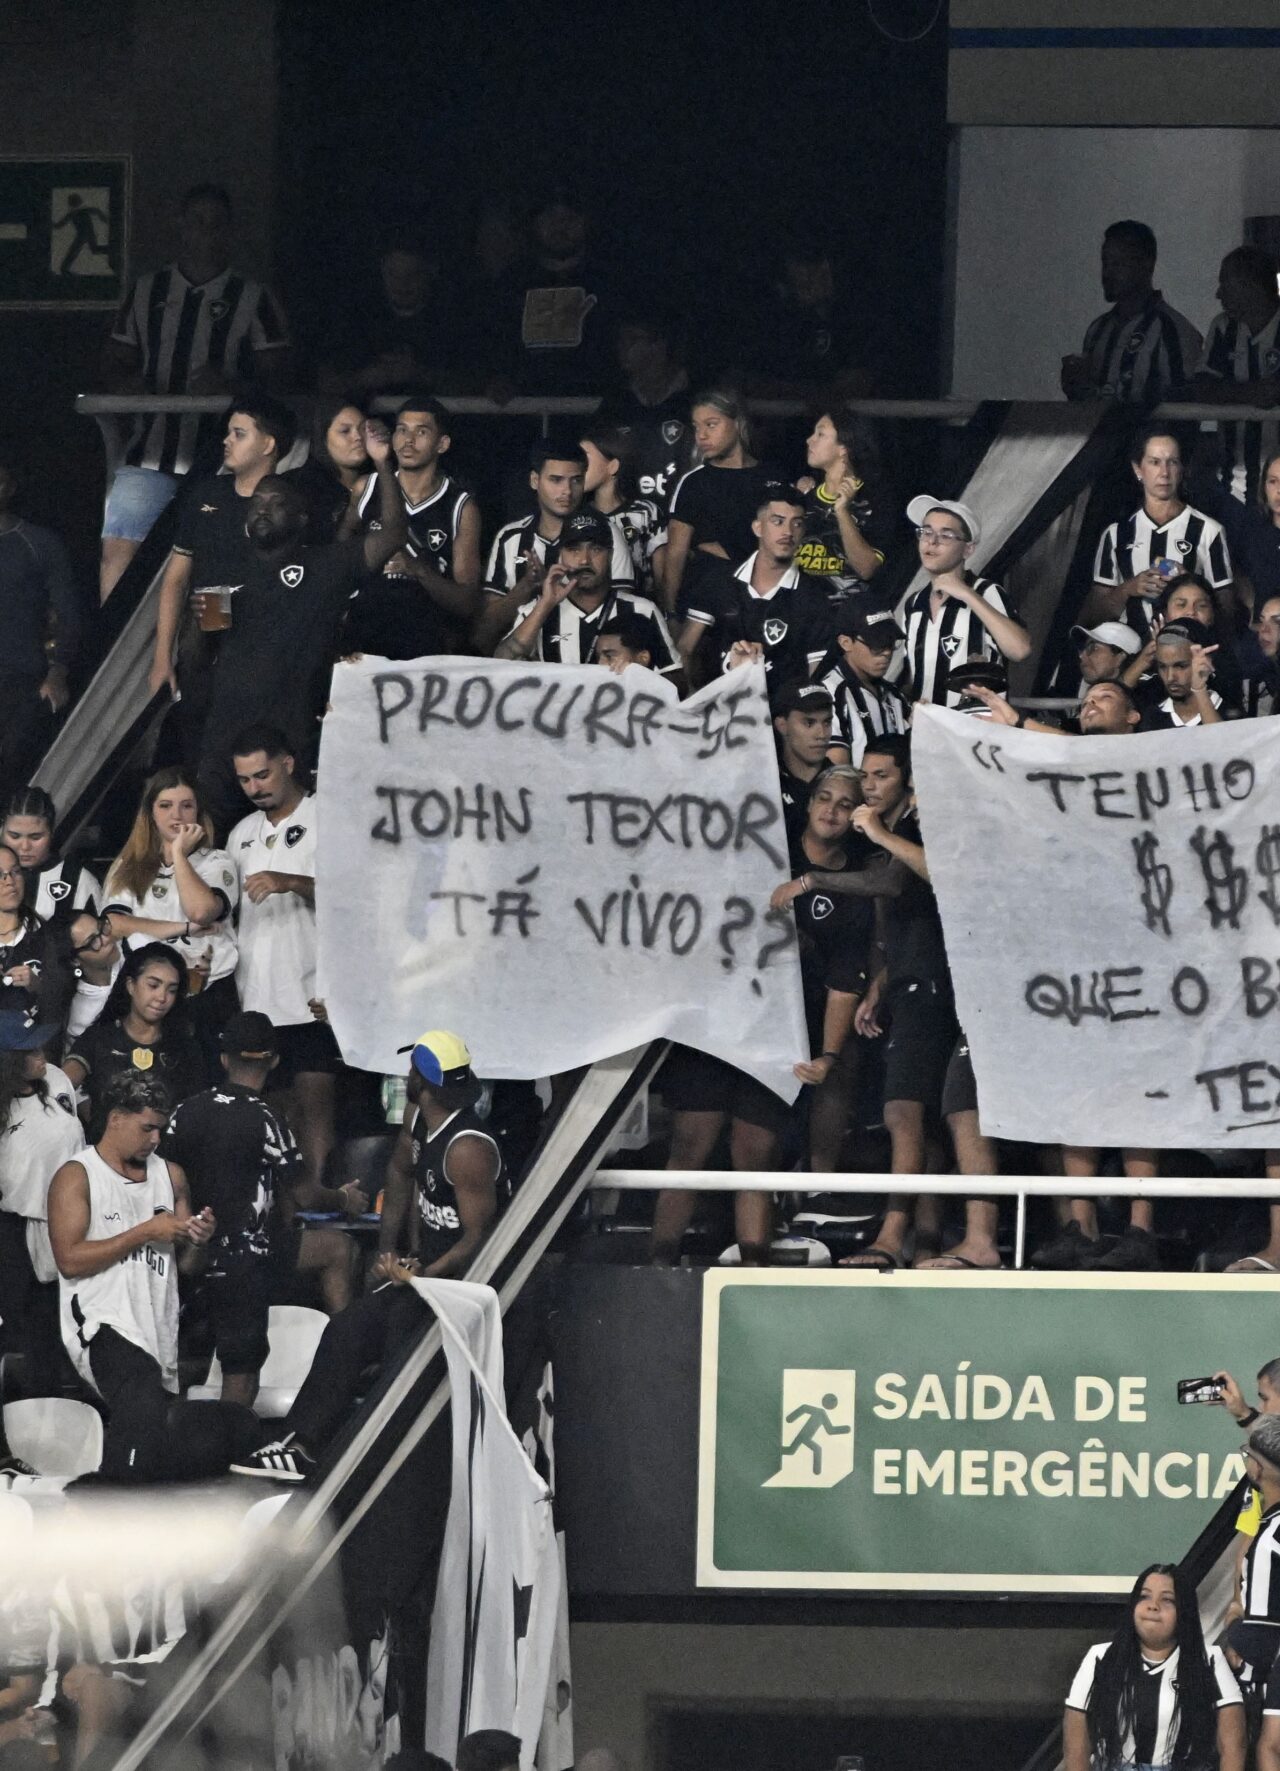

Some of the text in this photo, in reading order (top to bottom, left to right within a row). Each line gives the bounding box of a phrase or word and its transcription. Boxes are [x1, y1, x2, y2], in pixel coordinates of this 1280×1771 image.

[640, 473, 667, 496] et
[371, 783, 786, 870] JOHN TEXTOR
[430, 865, 540, 938] TÁ
[1024, 966, 1160, 1026] QUE
[1172, 966, 1209, 1016] O
[872, 1361, 1148, 1422] SAÍDA DE
[872, 1438, 1248, 1500] EMERGÊNCIA
